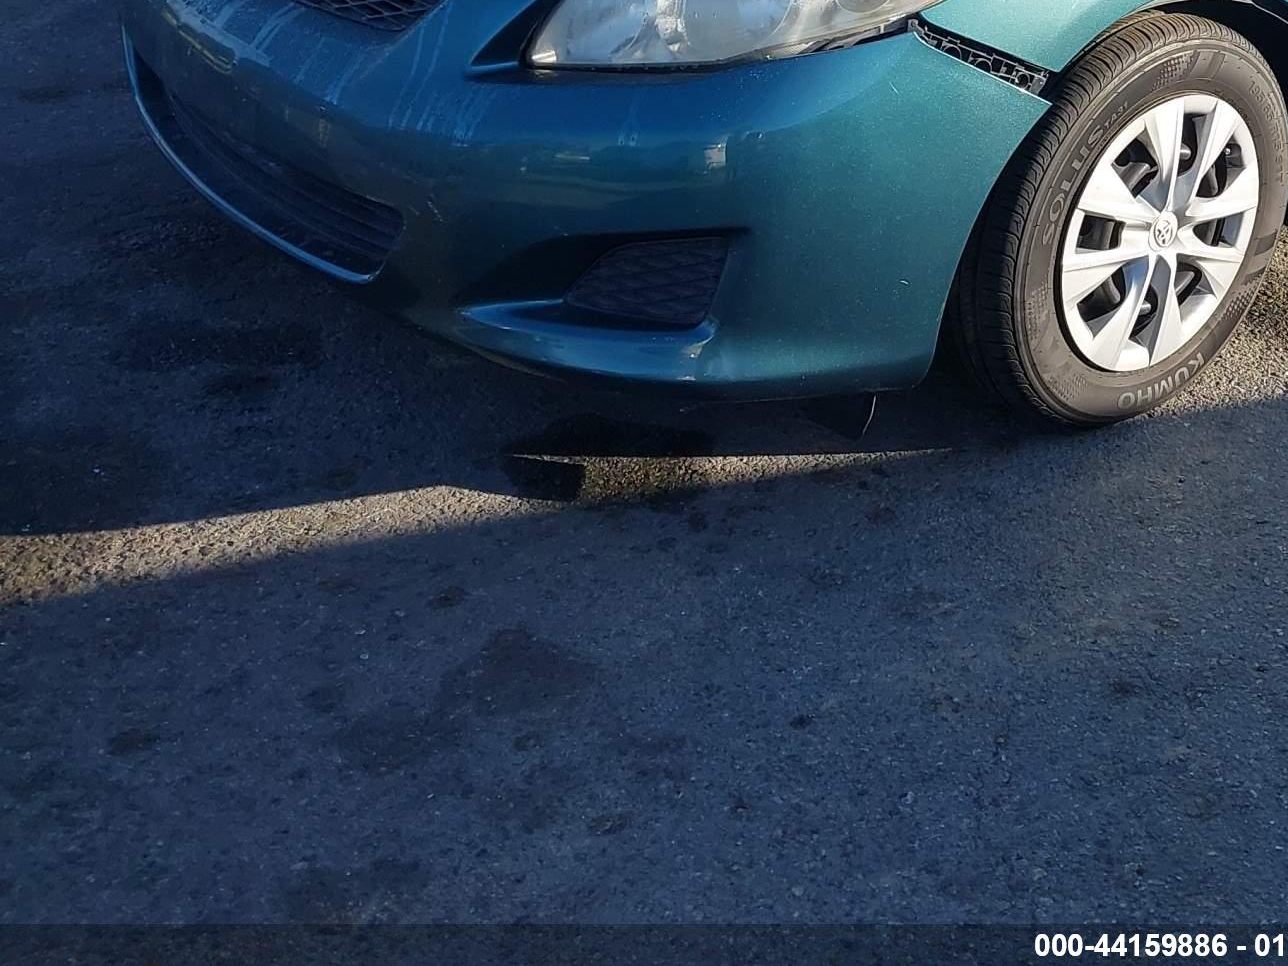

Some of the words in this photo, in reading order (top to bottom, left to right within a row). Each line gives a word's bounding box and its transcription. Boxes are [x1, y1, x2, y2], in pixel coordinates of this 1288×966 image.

[1042, 124, 1104, 245] SOLUS
[1104, 101, 1128, 129] TA31
[1117, 352, 1205, 410] KUMHO
